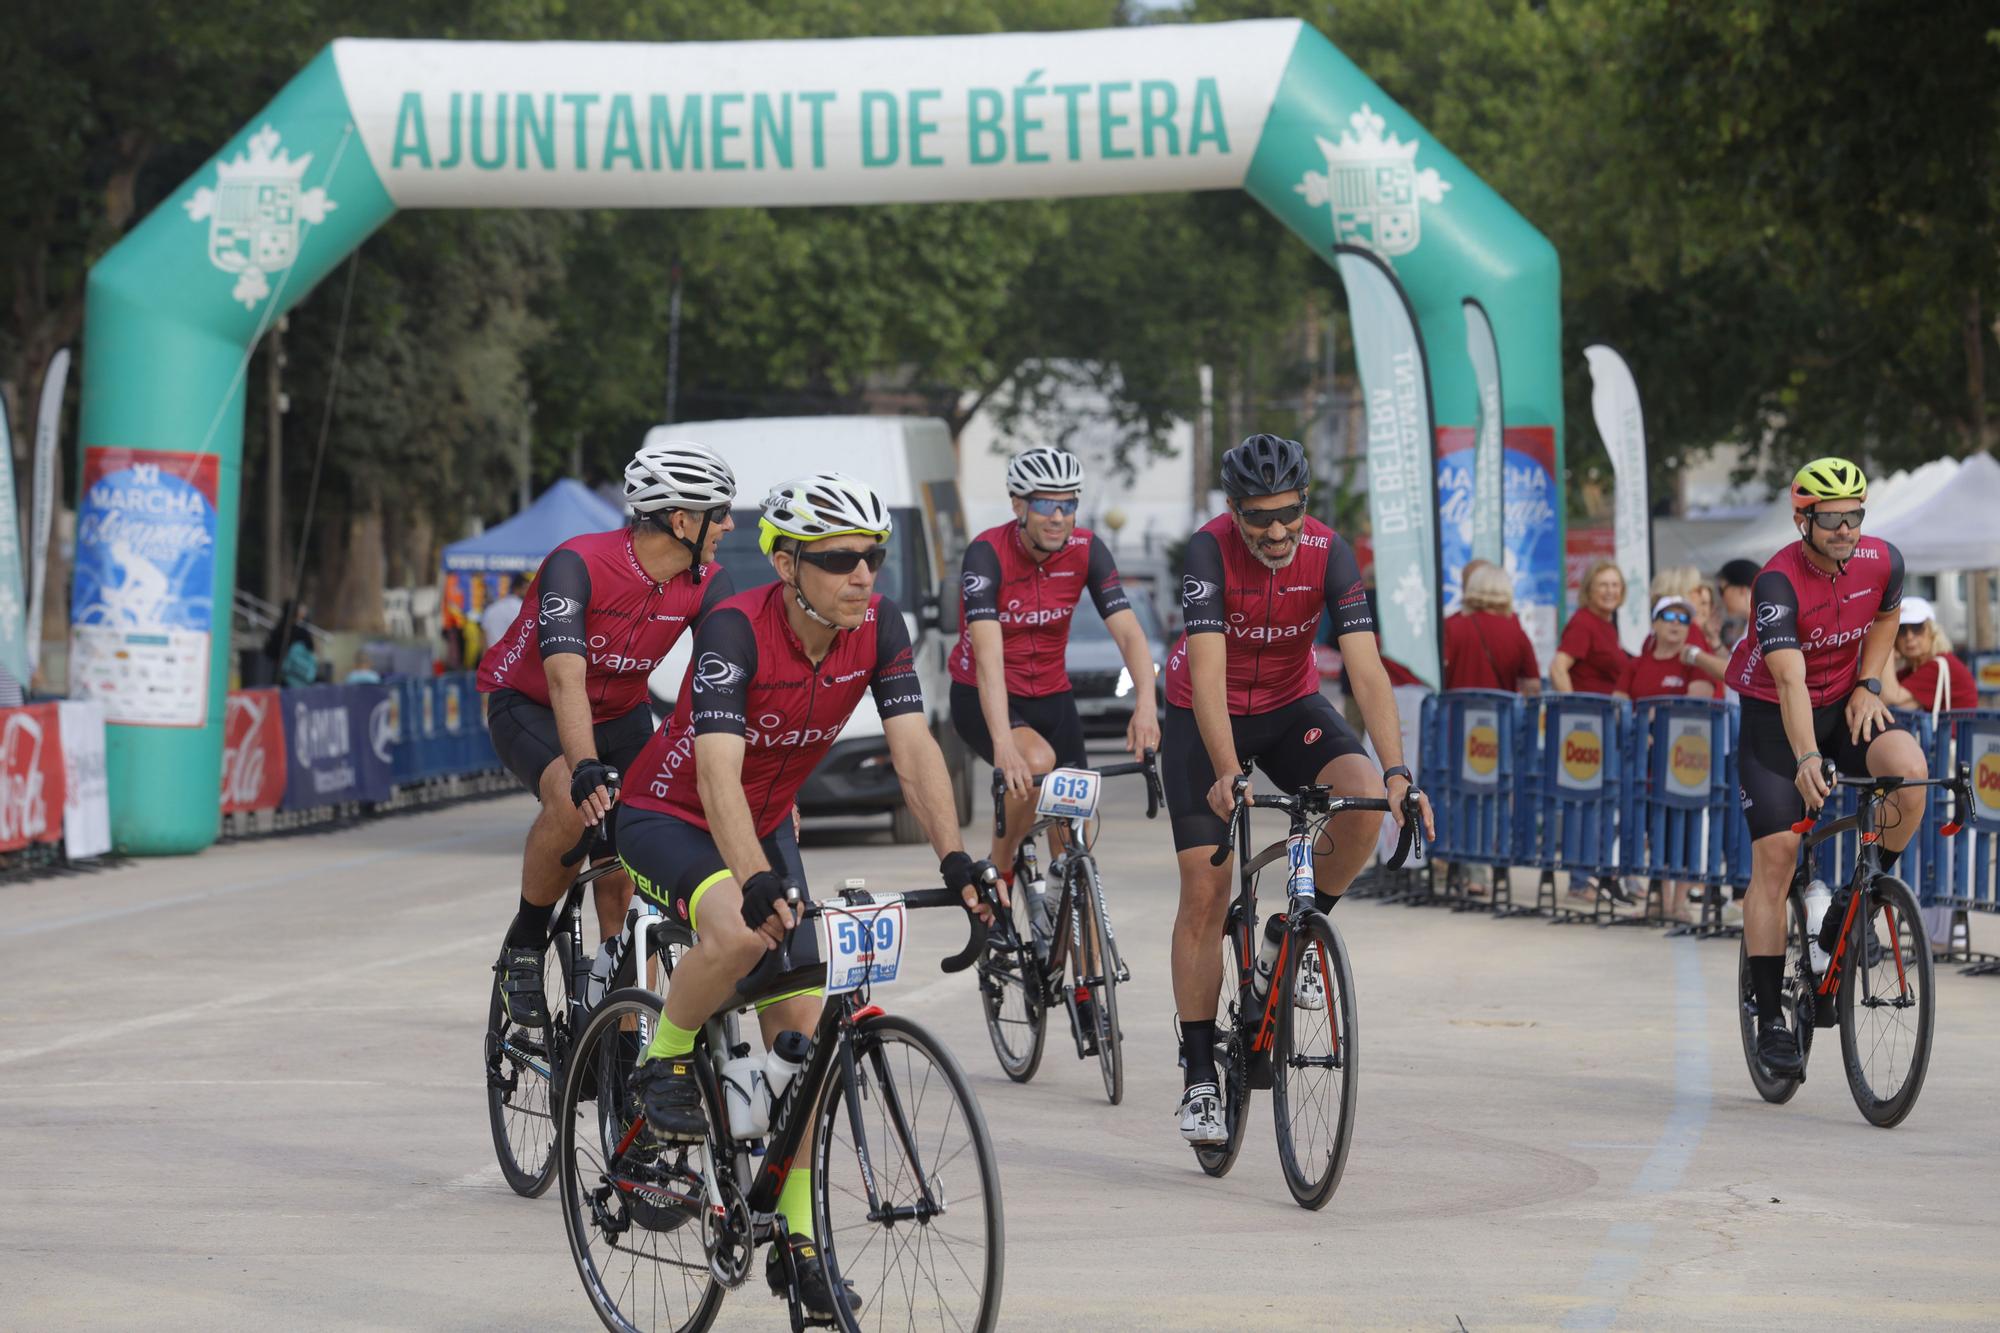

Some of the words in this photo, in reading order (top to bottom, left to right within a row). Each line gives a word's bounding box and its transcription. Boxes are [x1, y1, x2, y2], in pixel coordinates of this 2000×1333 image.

[391, 91, 837, 171] AJUNTAMENT
[860, 88, 944, 168] DE
[967, 67, 1232, 165] BÉTERA
[131, 462, 160, 484] XI
[89, 488, 205, 514] MARCHA
[626, 541, 654, 586] avapace
[999, 605, 1074, 626] avapac
[494, 618, 536, 682] avapace
[1800, 617, 1875, 651] avapac
[716, 687, 734, 695] VCV
[744, 713, 850, 748] avapac
[1052, 776, 1089, 799] 613
[838, 917, 894, 955] 569
